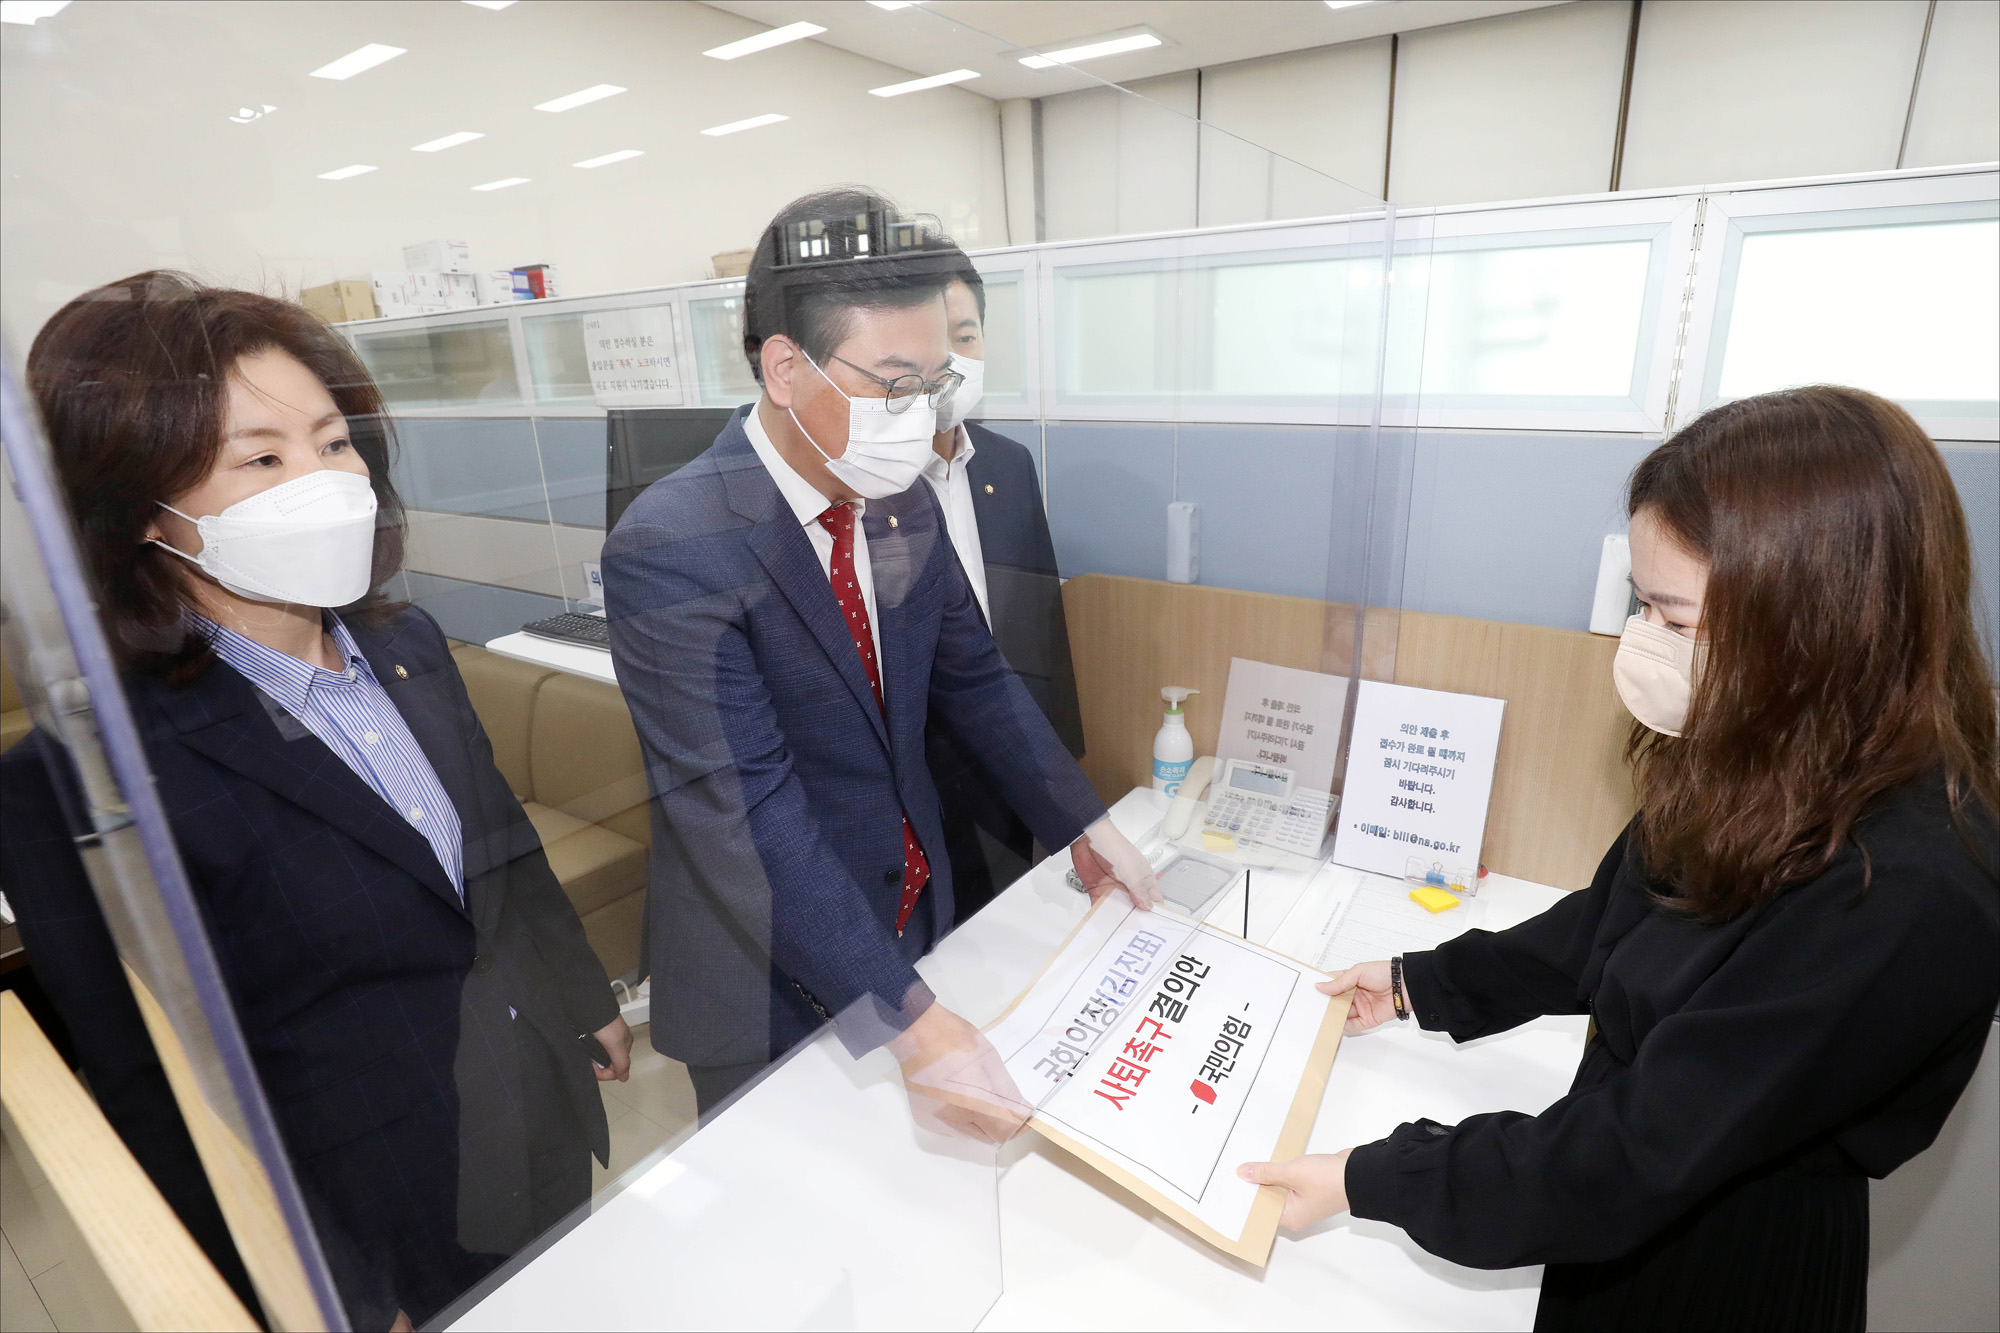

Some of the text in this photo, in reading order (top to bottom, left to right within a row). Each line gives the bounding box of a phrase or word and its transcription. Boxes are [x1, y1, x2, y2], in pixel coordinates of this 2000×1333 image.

[639, 335, 654, 347] 분은
[637, 356, 671, 368] 노크하시면
[630, 378, 673, 390] 나가겠습니다.
[1400, 723, 1450, 741] 의안 제출 후
[1379, 738, 1466, 763] 접수가 완료 될 때까지
[1383, 757, 1455, 780] 잠시 기다려주시기
[1398, 778, 1435, 795] 바랍니다.
[1390, 795, 1435, 814] 감사합니다.
[1360, 822, 1461, 853] 이메일: bill@na.go.kr
[1199, 1015, 1252, 1084] 국민의힘
